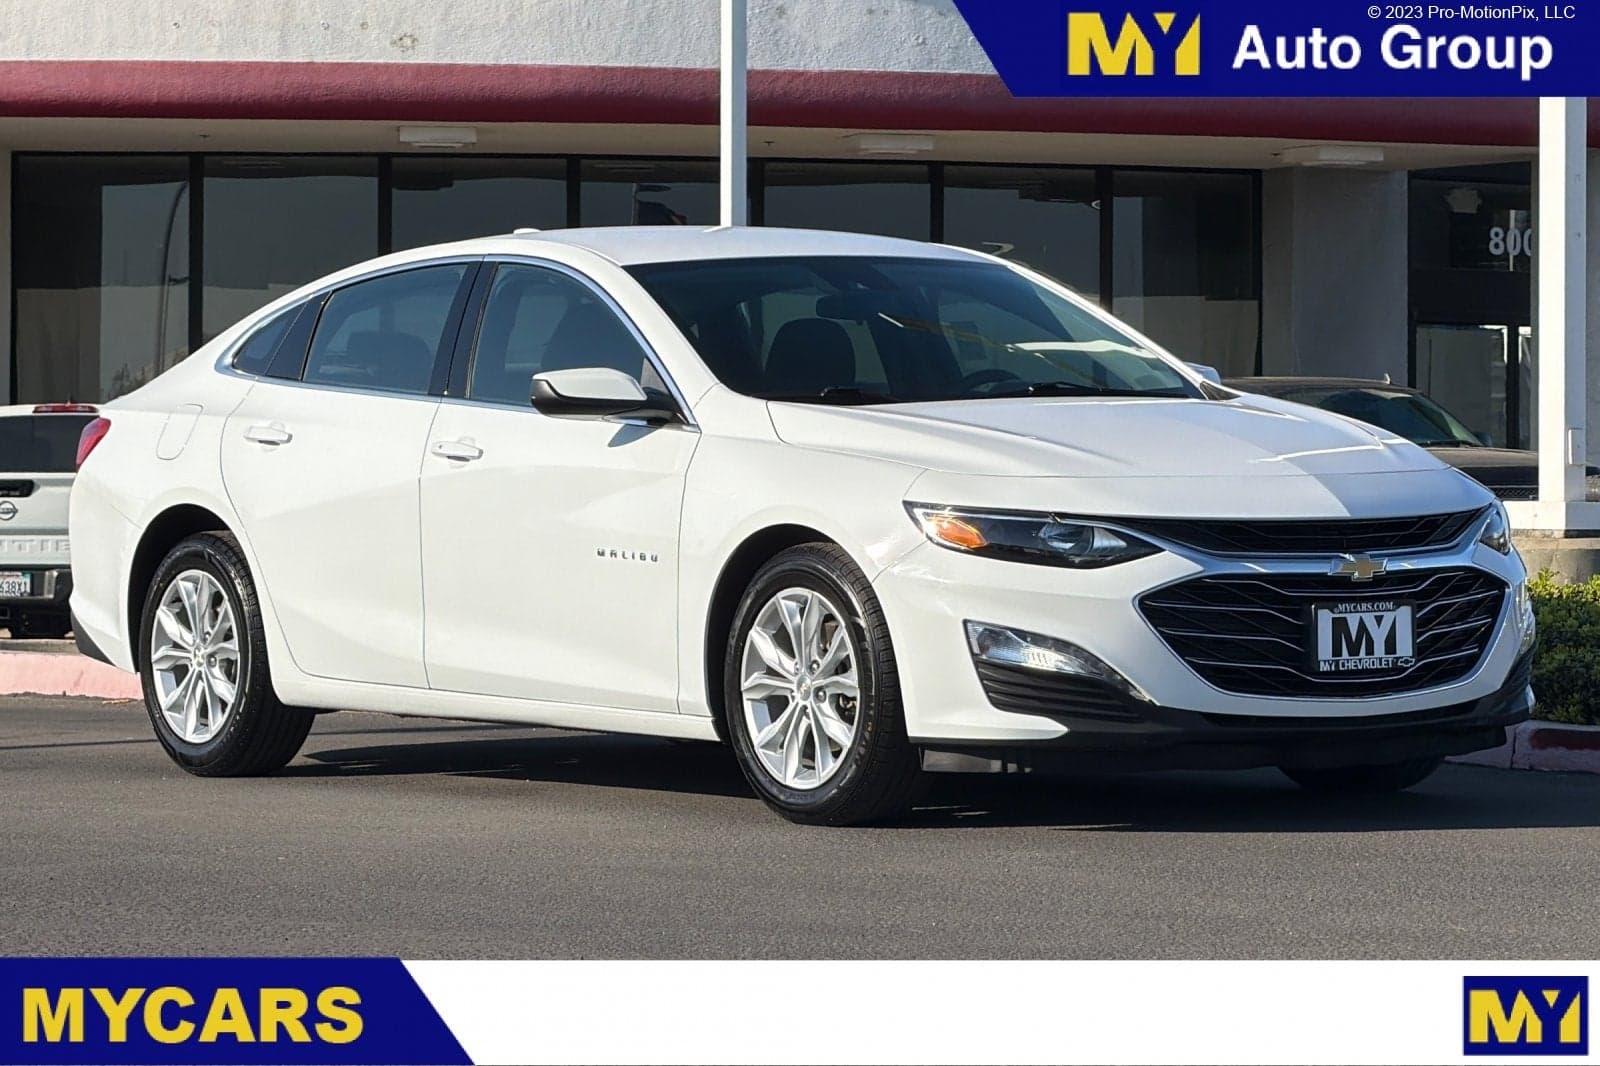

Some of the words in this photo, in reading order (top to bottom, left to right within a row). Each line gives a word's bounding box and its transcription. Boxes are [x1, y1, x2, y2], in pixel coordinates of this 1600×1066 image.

[597, 548, 658, 562] MALIBU
[1337, 601, 1394, 613] MYCARS.COM
[1331, 614, 1397, 658] MY
[1319, 660, 1335, 672] MY
[1339, 658, 1393, 671] CHEVROLET
